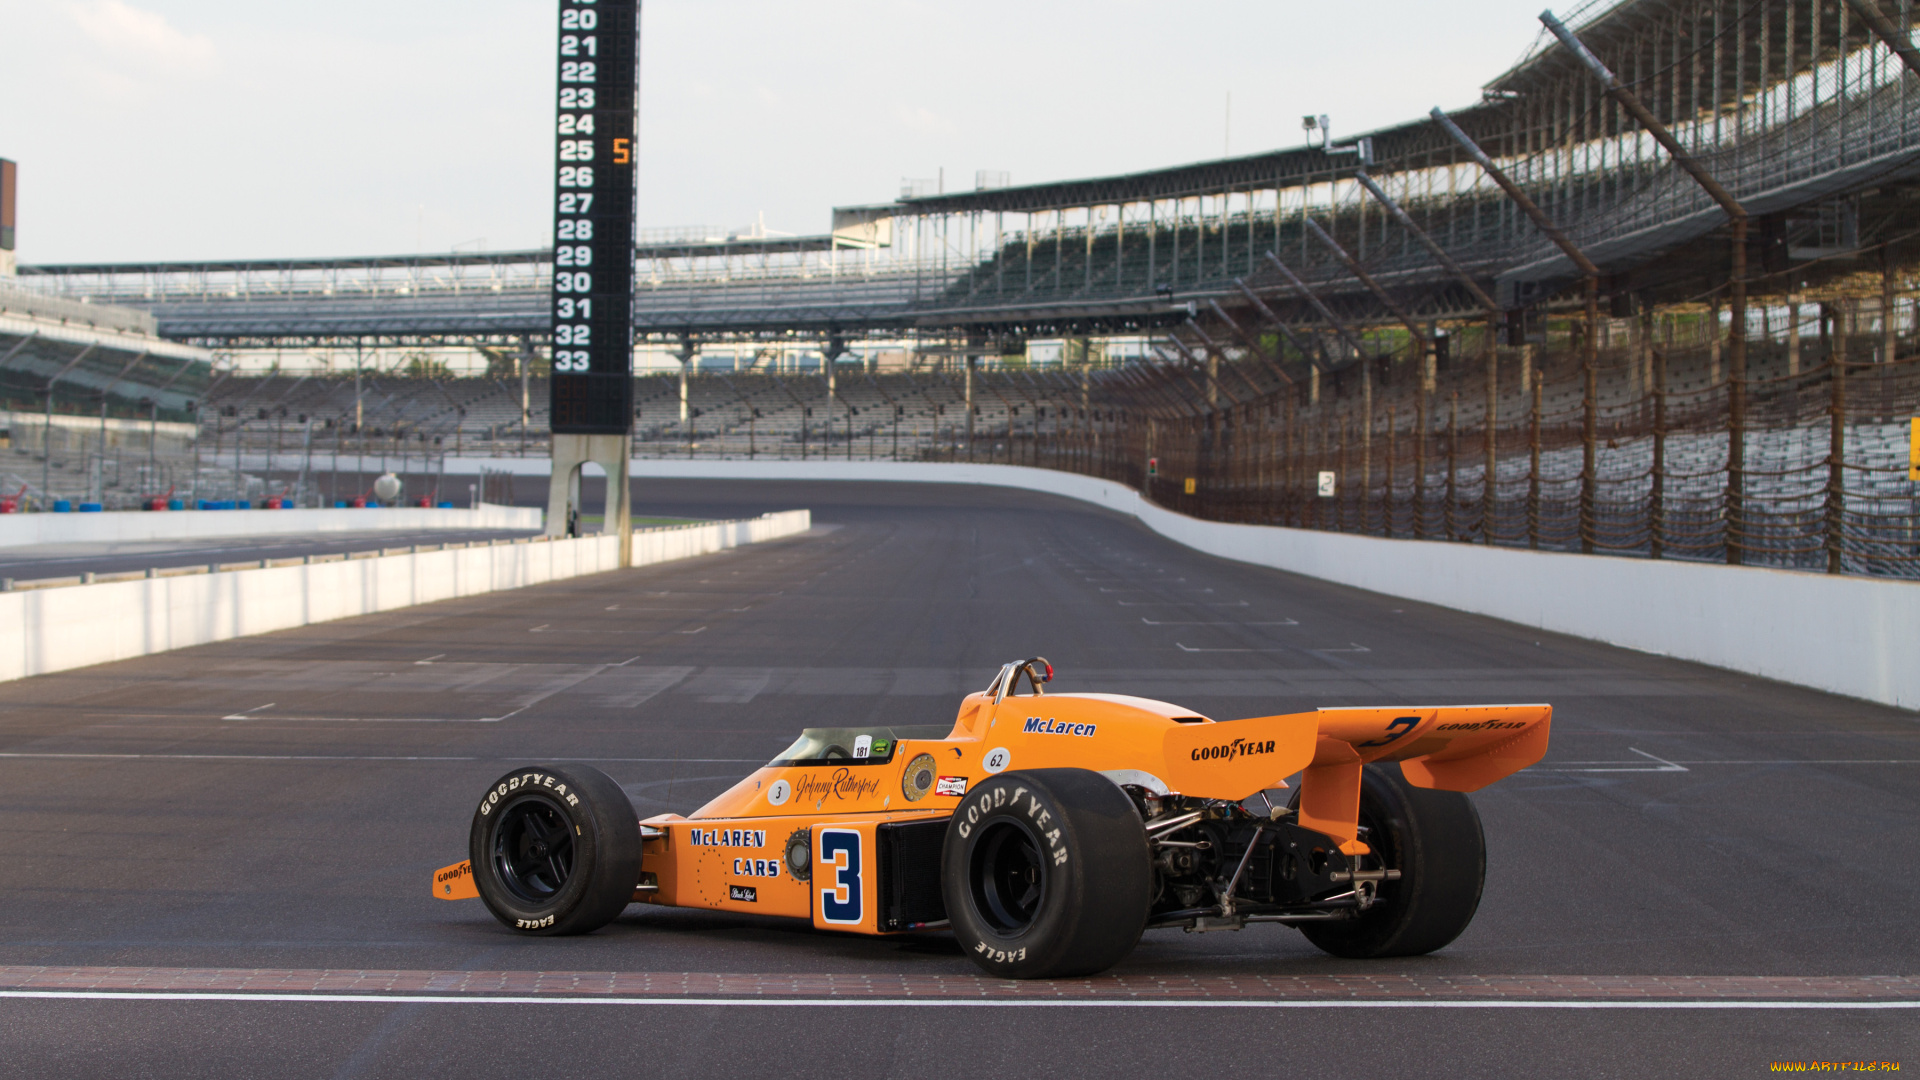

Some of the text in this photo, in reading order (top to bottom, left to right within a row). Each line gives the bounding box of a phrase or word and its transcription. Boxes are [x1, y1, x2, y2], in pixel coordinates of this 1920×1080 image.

[562, 9, 597, 30] 20
[561, 35, 597, 56] 21
[561, 61, 596, 82] 22
[560, 87, 595, 109] 23
[558, 114, 595, 135] 24
[560, 140, 595, 161] 25
[613, 138, 629, 163] 5
[559, 166, 594, 187] 26
[559, 192, 593, 213] 27
[558, 219, 593, 240] 28
[557, 245, 592, 266] 29
[556, 272, 591, 293] 30
[557, 298, 591, 319] 31
[555, 324, 590, 345] 32
[555, 350, 590, 372] 33
[1320, 475, 1333, 492] 2
[1023, 717, 1096, 737] McLaren
[1436, 719, 1527, 732] GOODYEAR
[856, 747, 868, 757] 181
[990, 753, 1003, 767] 62
[1191, 737, 1276, 763] GOODYEAR
[481, 773, 579, 816] GOODYEAR
[775, 786, 782, 799] 3
[795, 768, 880, 803] Johnny Rutherford
[938, 782, 965, 790] CHAMPION
[958, 786, 1068, 867] GOODYEAR
[691, 828, 766, 848] McLAREN
[438, 863, 472, 882] GOODYE
[733, 857, 780, 877] CARS
[820, 828, 863, 924] 3
[515, 914, 554, 929] EAGLE
[974, 941, 1027, 963] EAGLE
